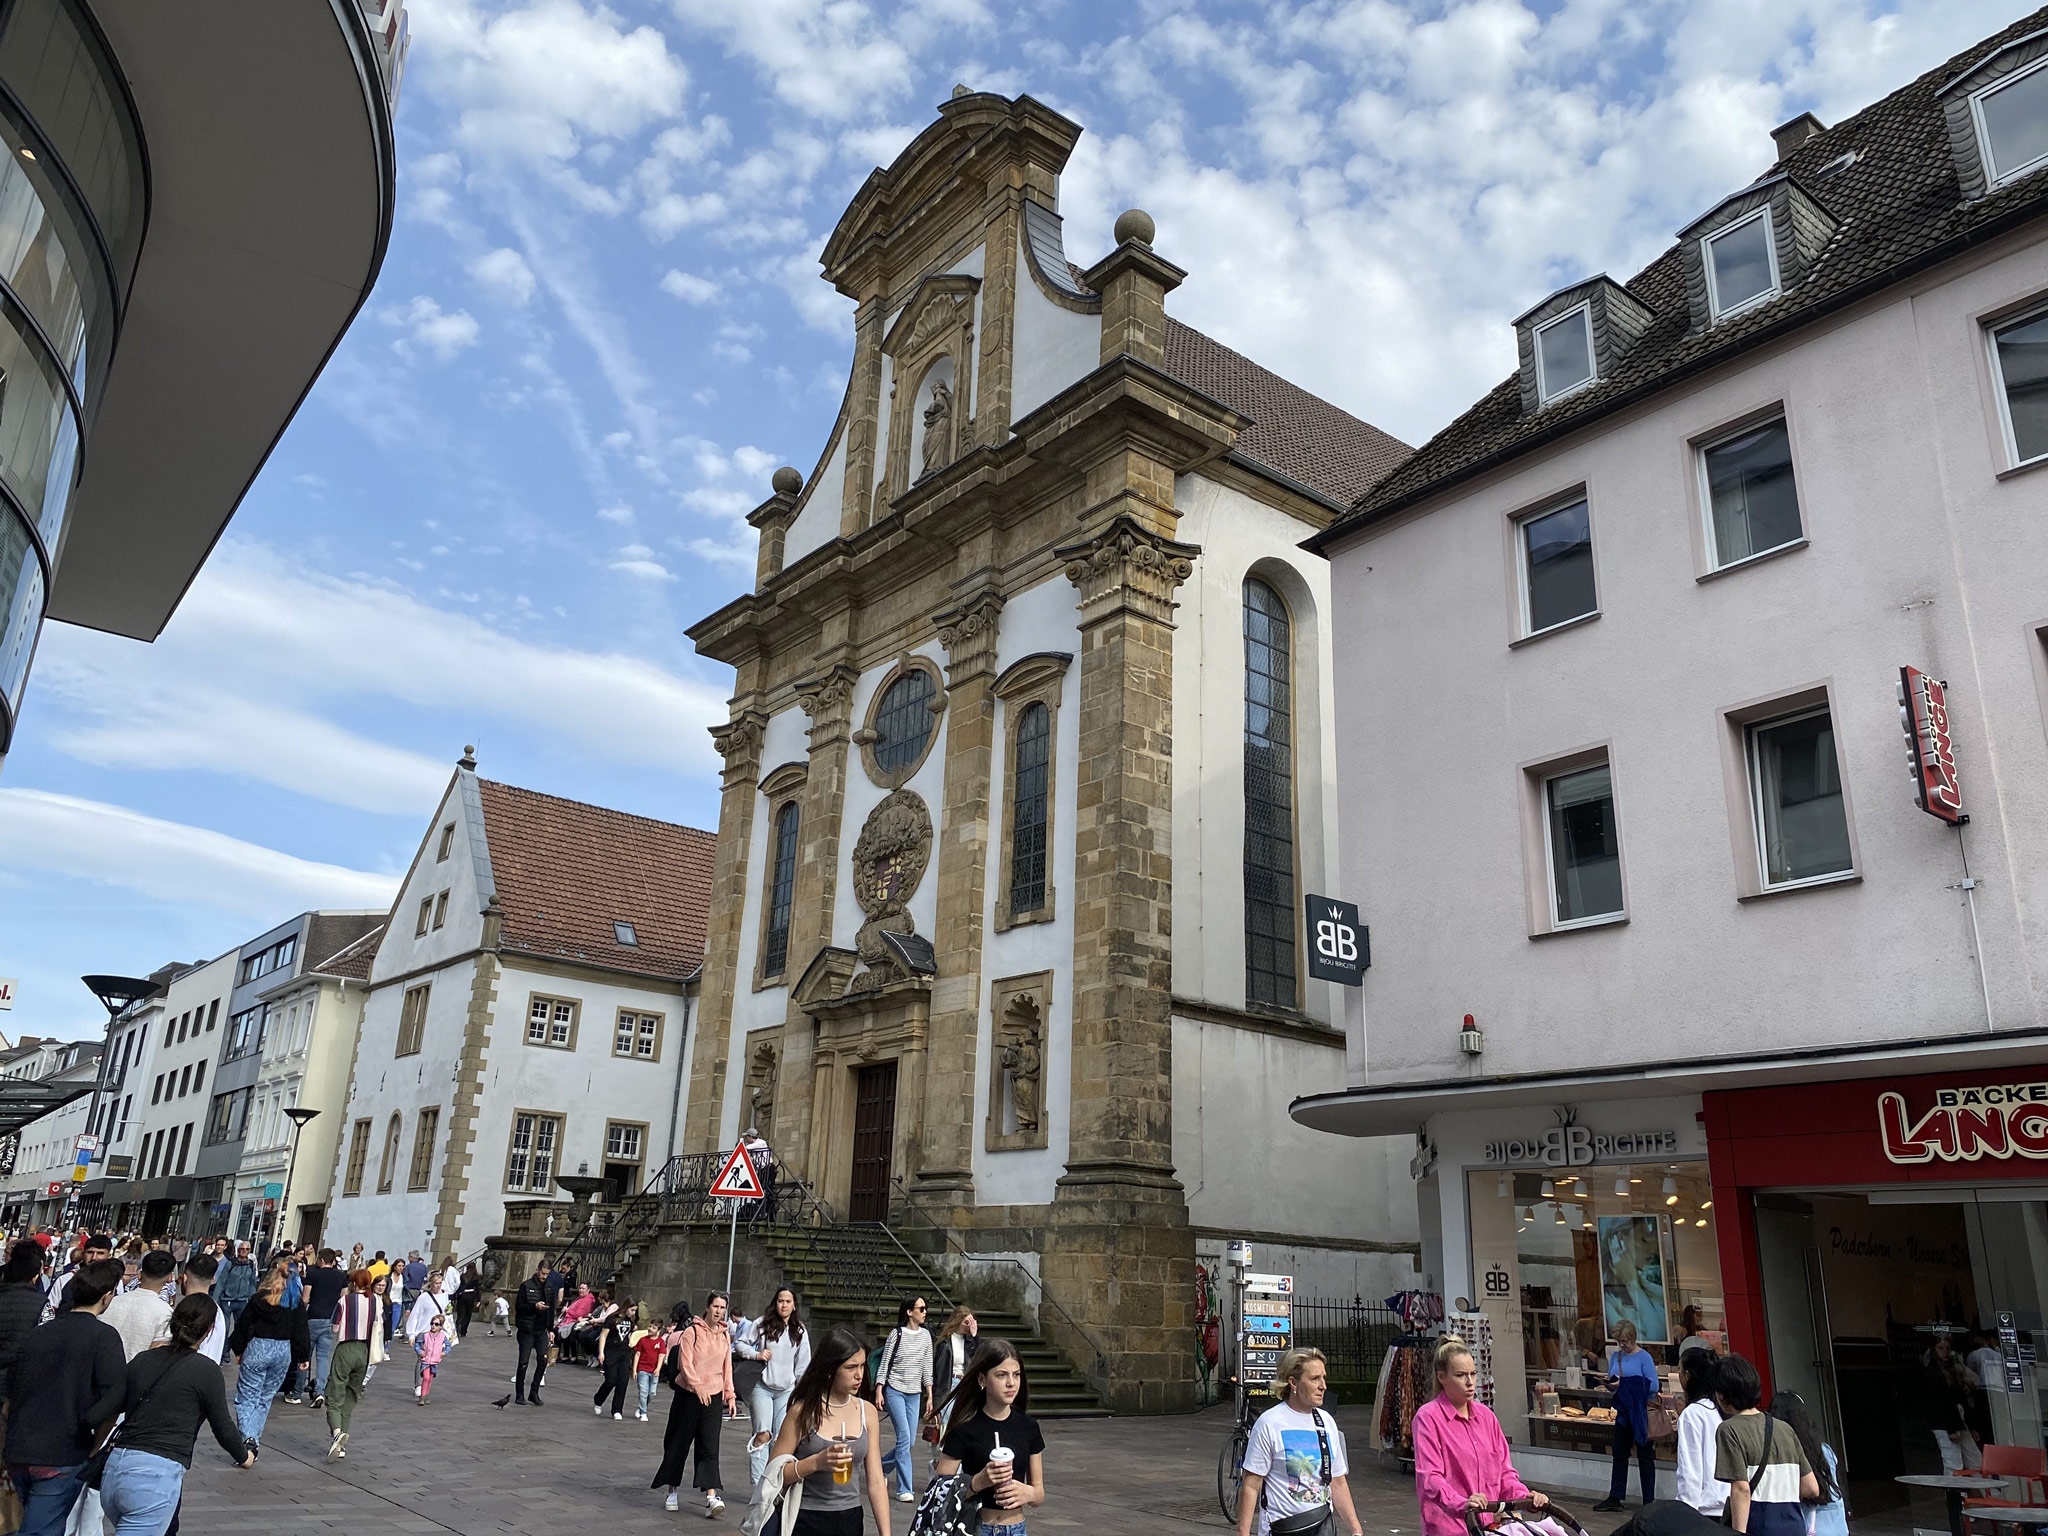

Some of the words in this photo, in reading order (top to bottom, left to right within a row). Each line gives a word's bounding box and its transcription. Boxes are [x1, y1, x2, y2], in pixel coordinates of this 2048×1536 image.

[1928, 678, 1961, 809] LANGE
[1245, 1302, 1275, 1314] KOSMETIK
[1255, 1335, 1279, 1345] TOMS
